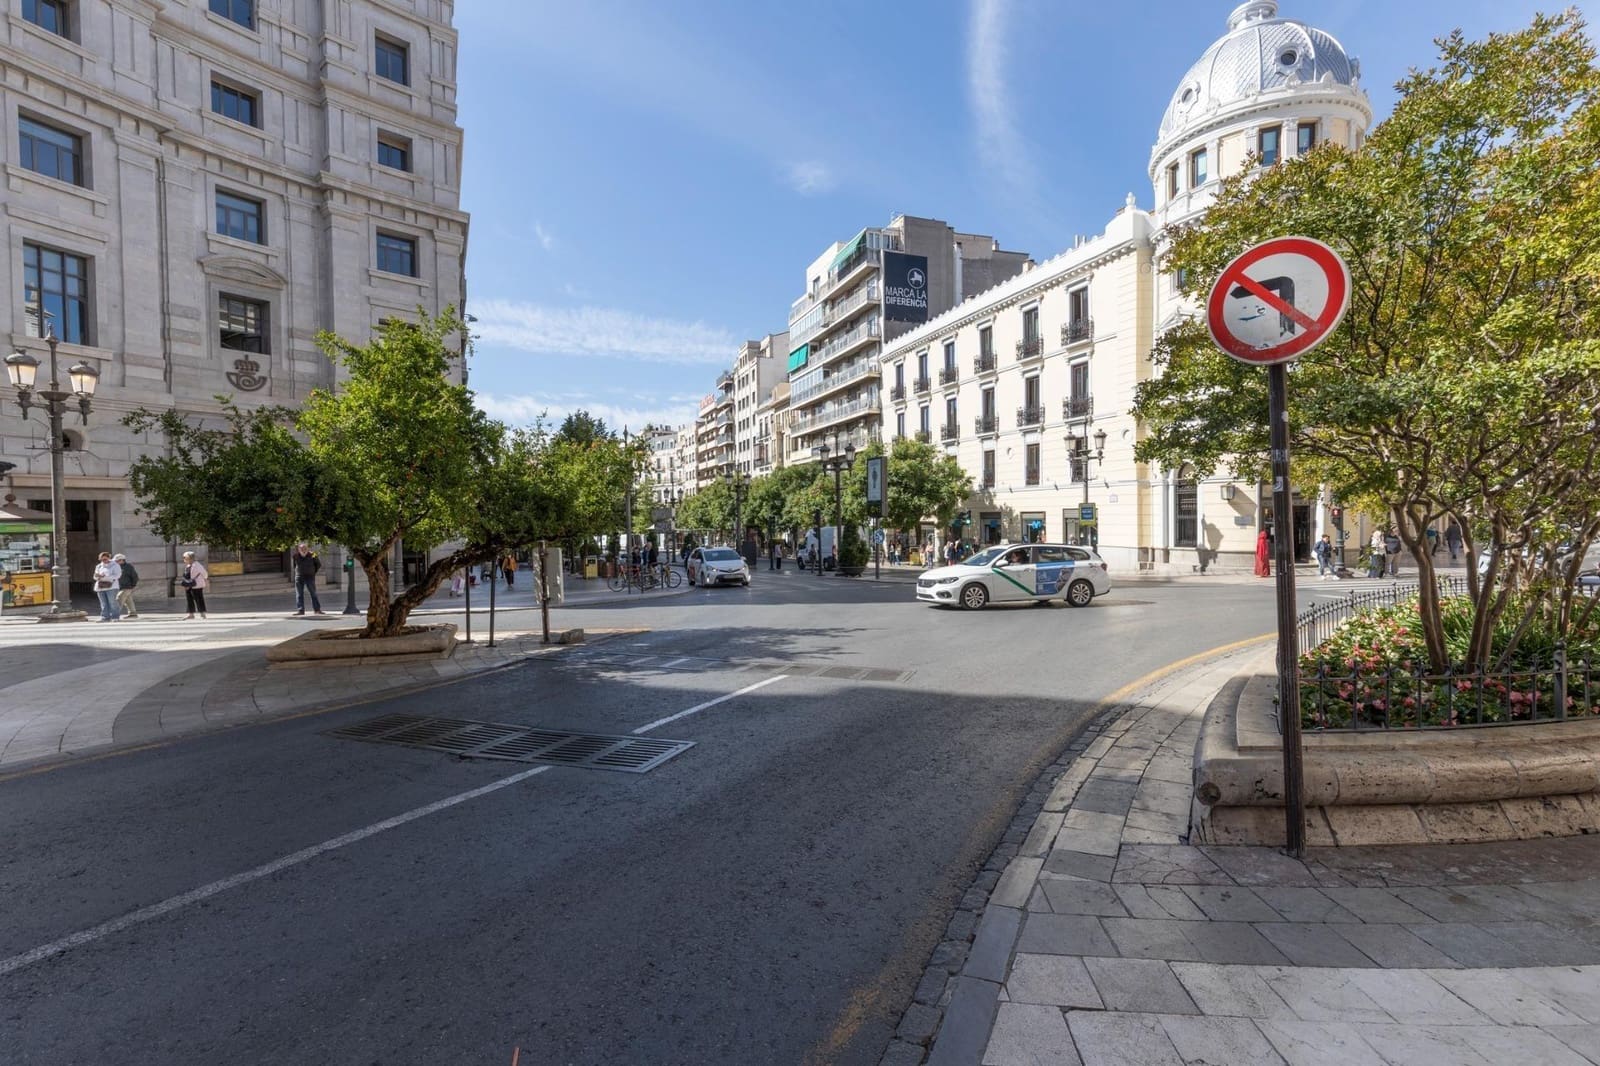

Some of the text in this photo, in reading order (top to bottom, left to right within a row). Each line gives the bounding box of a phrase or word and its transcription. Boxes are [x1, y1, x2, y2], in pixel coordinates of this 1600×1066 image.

[885, 286, 927, 299] MARCA LA
[885, 296, 927, 308] DIFERENCIA
